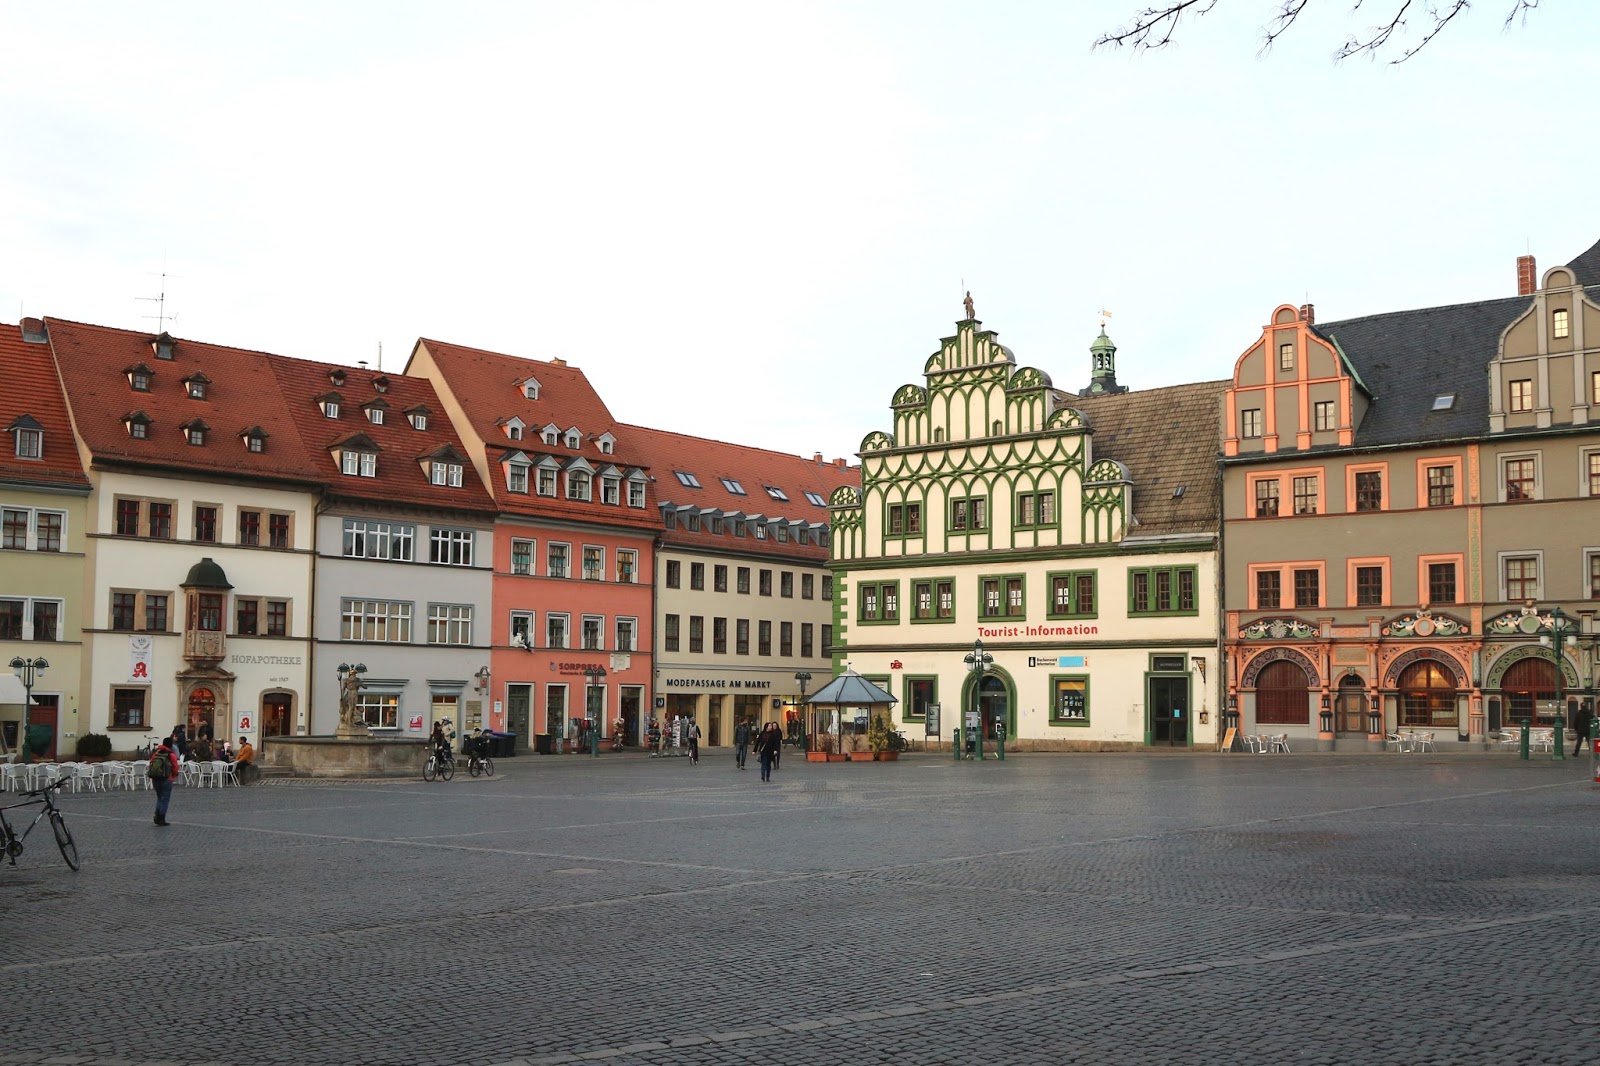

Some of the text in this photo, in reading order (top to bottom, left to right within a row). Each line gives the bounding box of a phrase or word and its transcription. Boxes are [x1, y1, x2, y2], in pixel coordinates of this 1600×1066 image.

[231, 654, 302, 665] HOFAPOTHEKE
[558, 662, 605, 671] SORPRESA
[666, 678, 771, 689] MODEPASSAGE AM MARKT
